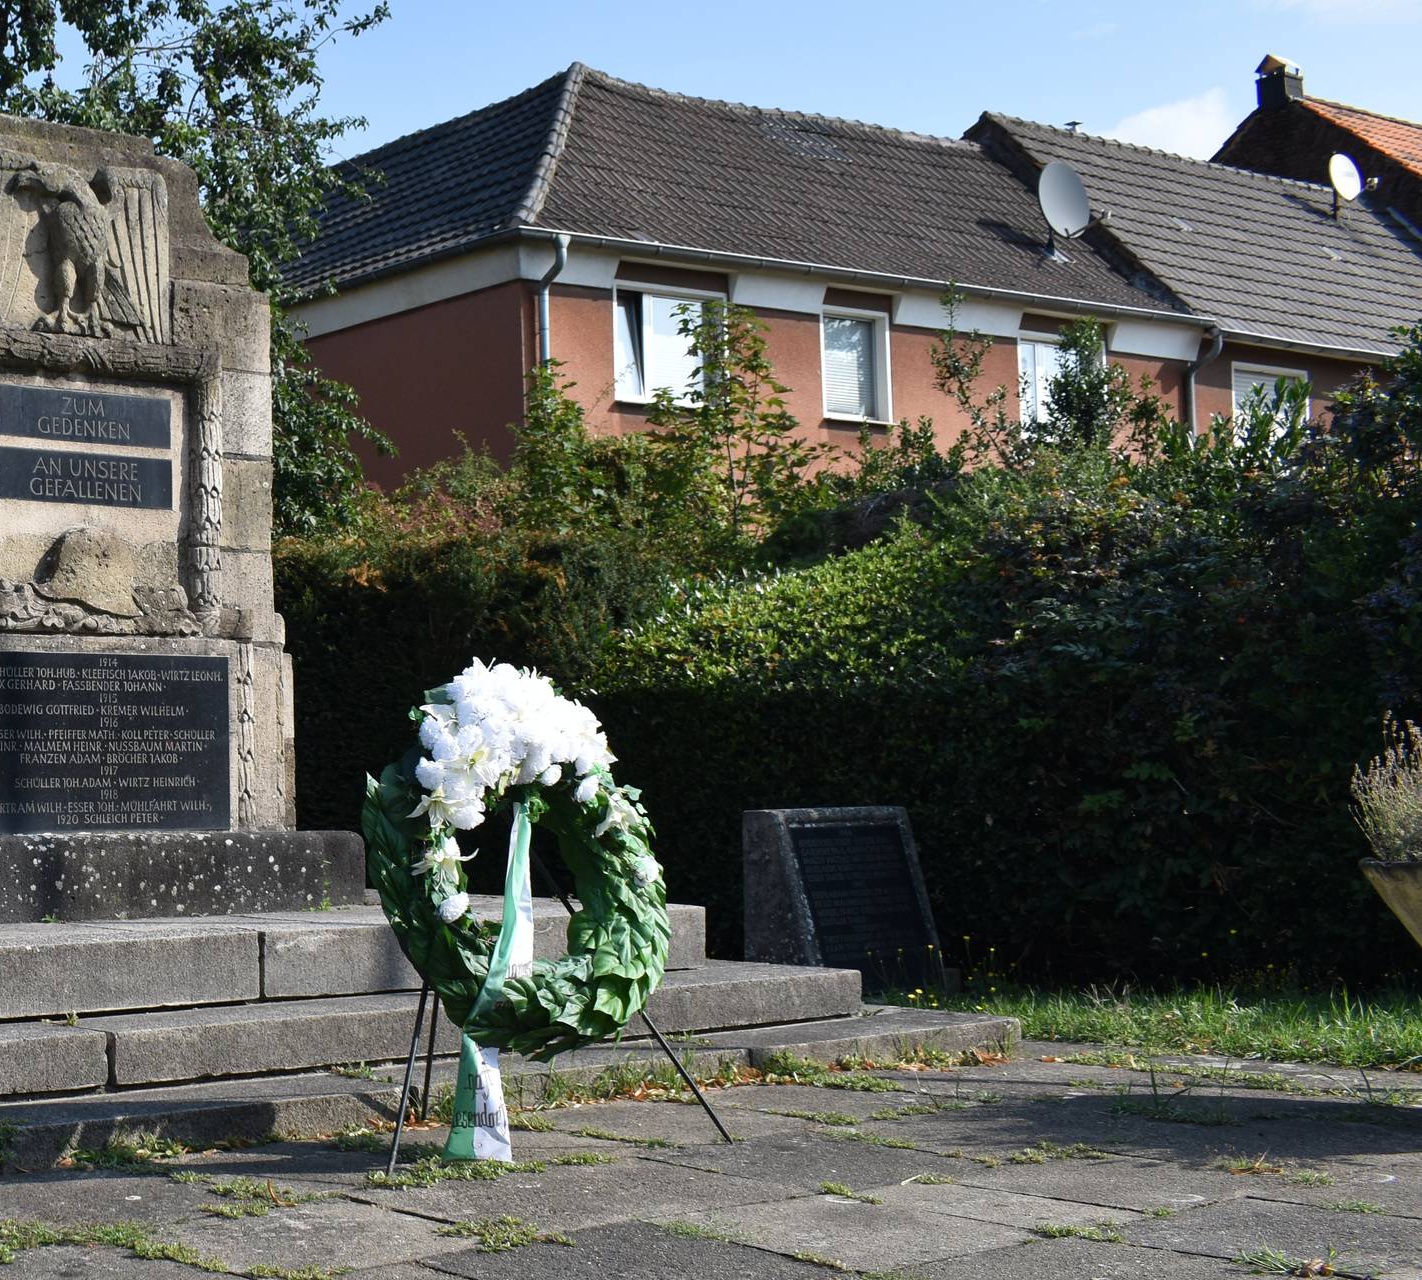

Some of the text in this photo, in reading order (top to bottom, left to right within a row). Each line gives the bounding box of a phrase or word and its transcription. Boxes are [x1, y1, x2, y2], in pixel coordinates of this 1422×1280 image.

[61, 396, 105, 417] ZUM
[37, 416, 130, 440] GEDENKEN
[32, 457, 138, 481] AN UNSERE
[29, 477, 142, 502] GEFALLENEN
[99, 658, 118, 667] 1914
[82, 669, 126, 679] KLEEFISCH
[128, 669, 157, 680] JAKOB
[161, 670, 190, 681] WIRTZ
[7, 679, 55, 690] GERHARD
[62, 680, 120, 692] FASSBENDER
[123, 681, 162, 692] JOHANN
[99, 693, 118, 703] 1915
[46, 704, 94, 715] GOTTFRIED
[101, 705, 138, 716] KREMER
[140, 705, 184, 716] WILHELM
[100, 717, 118, 727] 1916
[49, 729, 87, 740] PFEIFFER
[121, 730, 142, 740] KOLL
[144, 730, 169, 740] PETER
[24, 741, 71, 752] MALMEM
[108, 741, 163, 752] NUSSBAUM
[165, 741, 203, 752] MARTIN
[20, 753, 66, 764] FRANZEN
[69, 753, 100, 764] ADAM
[149, 754, 178, 764] JAKOB
[100, 765, 118, 775] 1917
[119, 777, 149, 788] WIRTZ
[153, 776, 196, 787] HEINRICH
[100, 789, 119, 800] 1918
[68, 802, 95, 812] ESSER
[57, 813, 159, 825] 1920 SCHLEICH PETER
